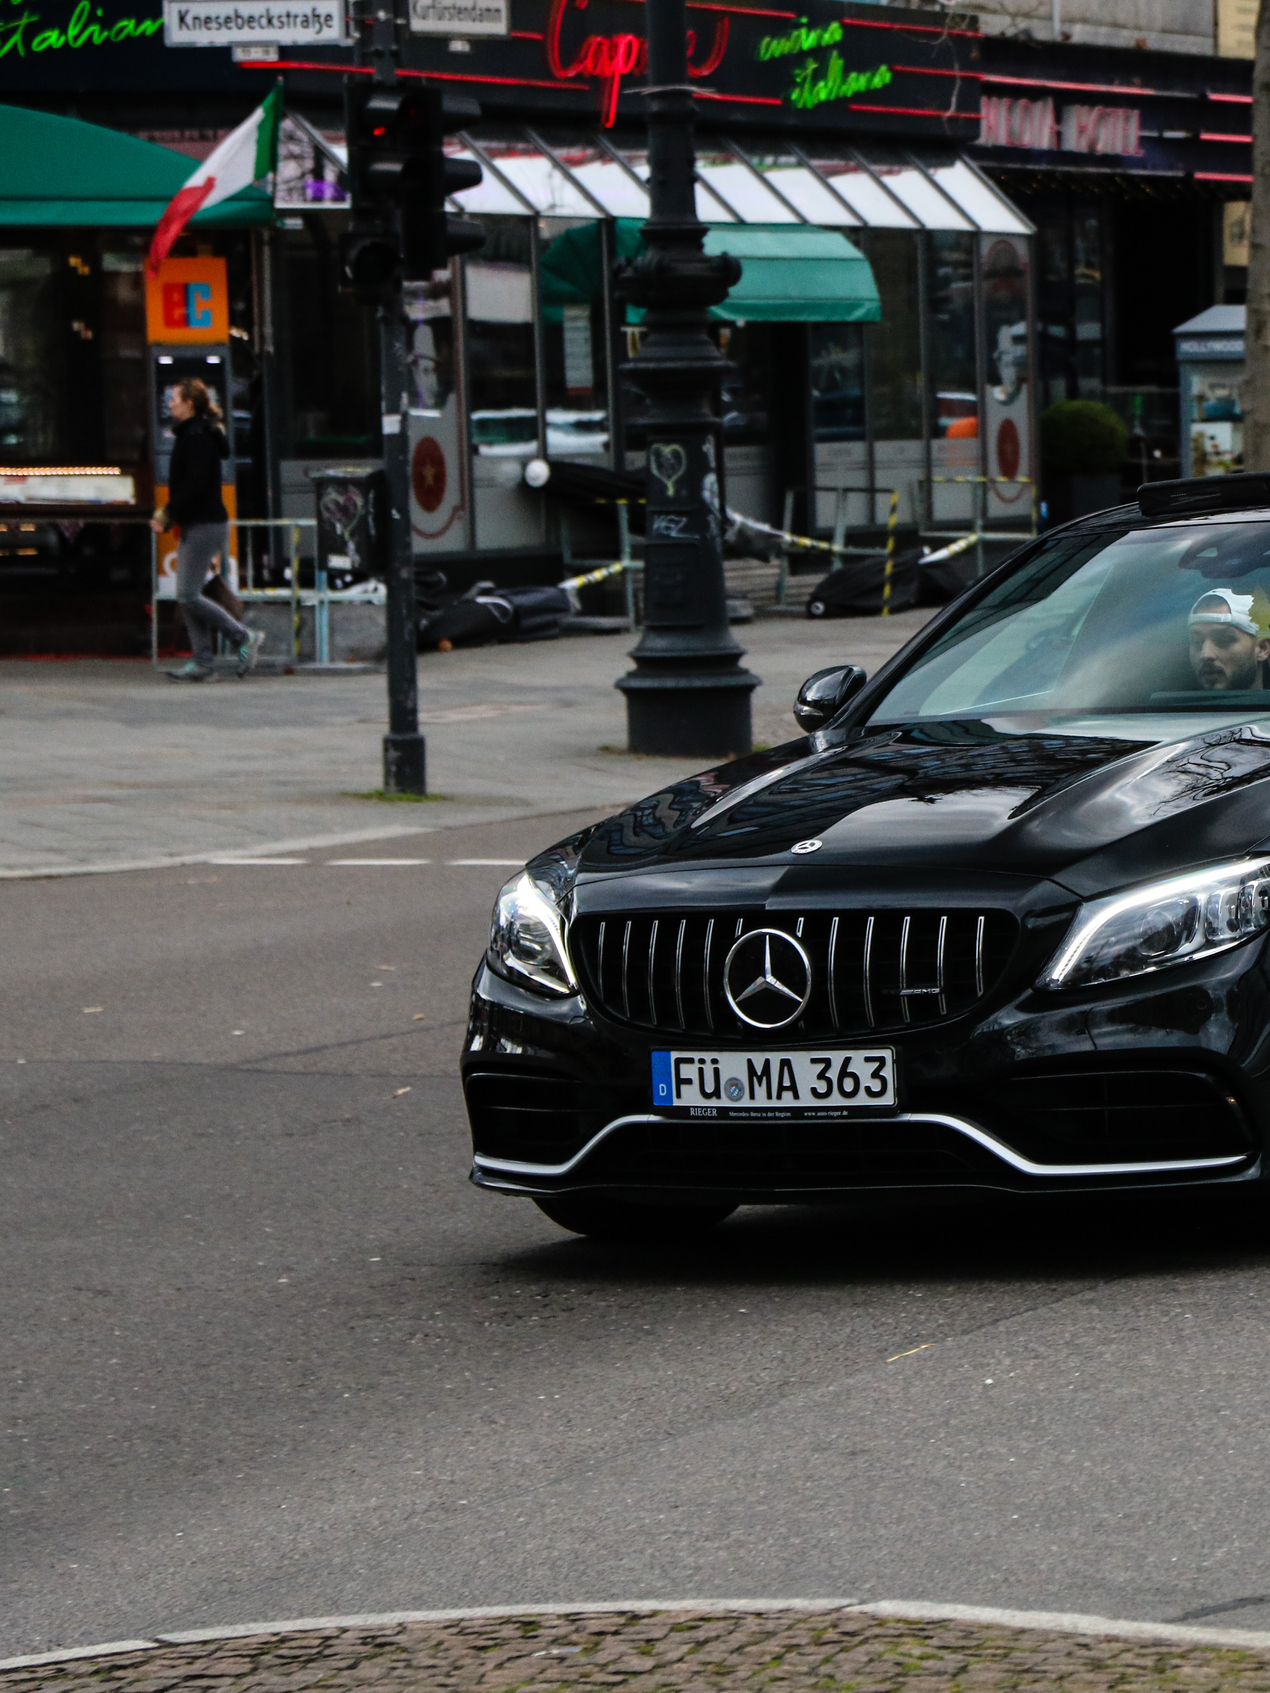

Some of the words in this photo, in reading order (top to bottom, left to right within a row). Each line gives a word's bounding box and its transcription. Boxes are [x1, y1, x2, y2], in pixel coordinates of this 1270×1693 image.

[177, 7, 334, 35] Knesebeckstraße
[1062, 104, 1145, 156] HOTEL
[659, 1083, 667, 1096] D
[673, 1056, 722, 1100] FÜ
[746, 1057, 800, 1101] MA
[809, 1055, 888, 1099] 363
[689, 1107, 718, 1117] RIEGER
